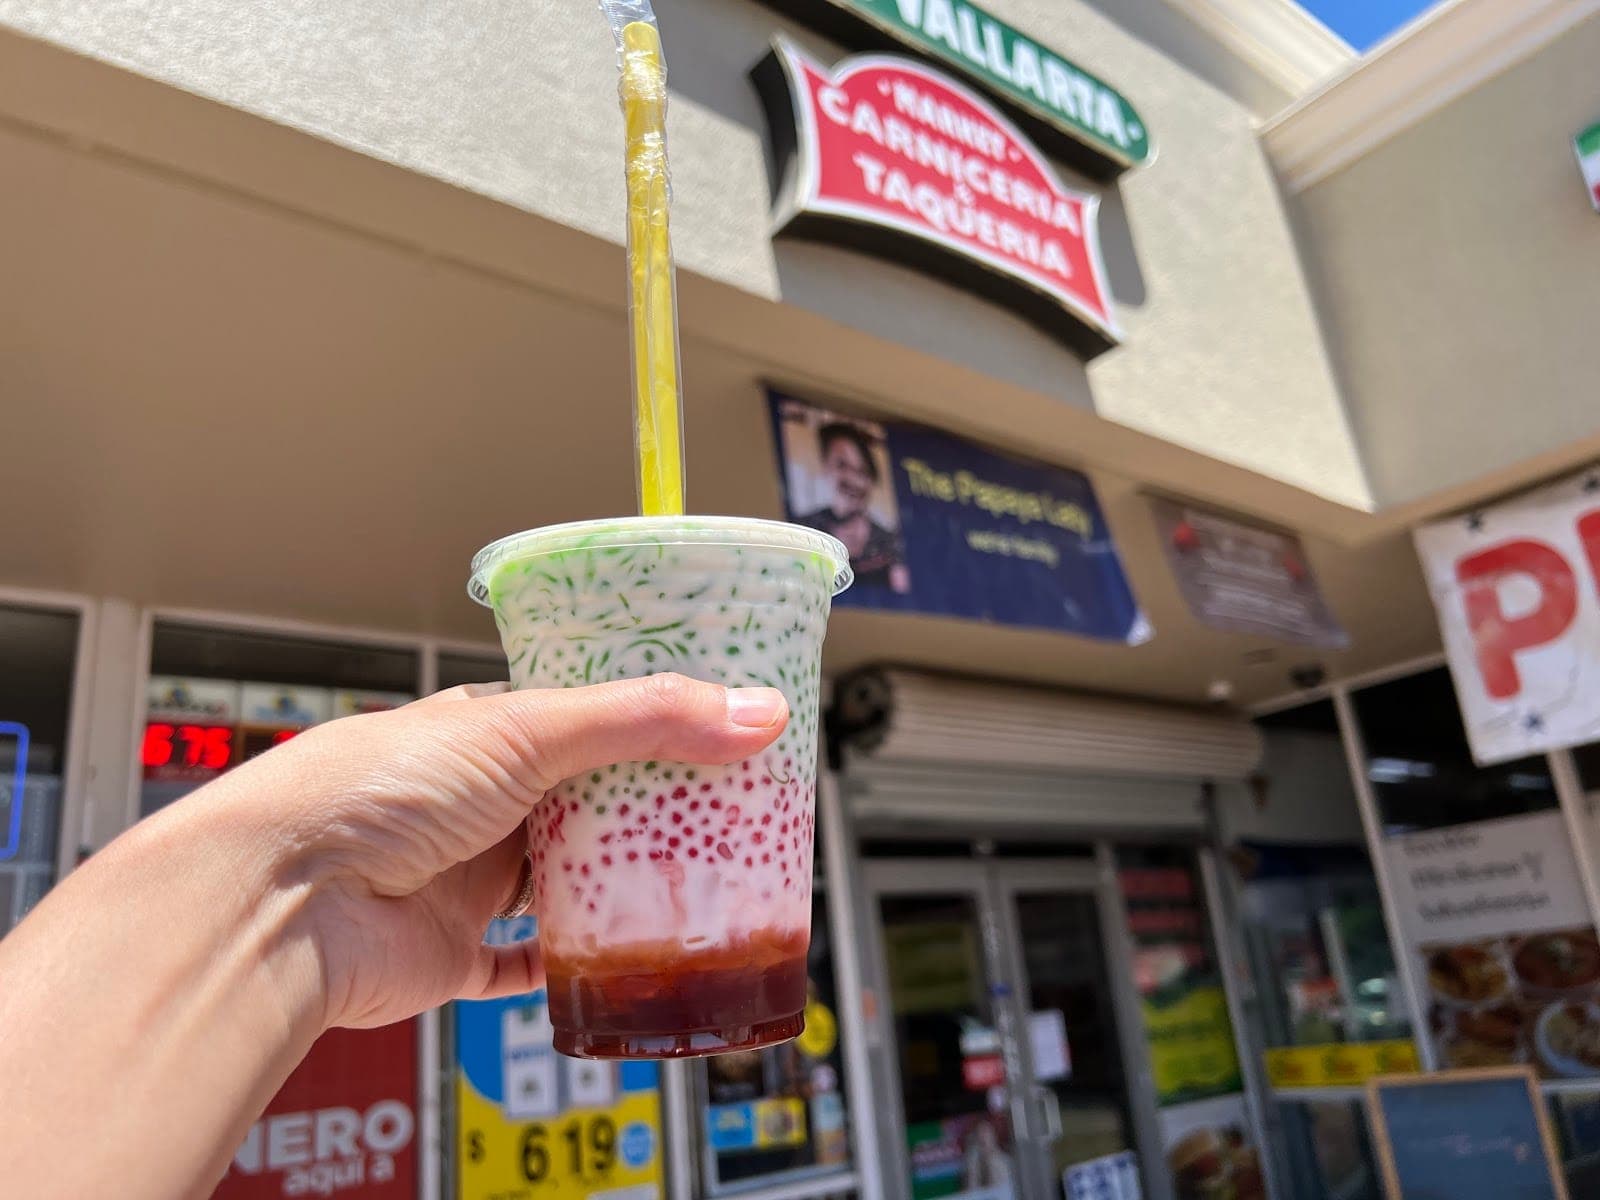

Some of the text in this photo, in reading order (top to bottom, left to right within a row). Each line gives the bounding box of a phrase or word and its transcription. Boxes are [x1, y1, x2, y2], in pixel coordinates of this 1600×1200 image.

[818, 86, 1081, 238] CARNICERIA
[853, 153, 1073, 278] TAQUERIA
[902, 457, 956, 502] The
